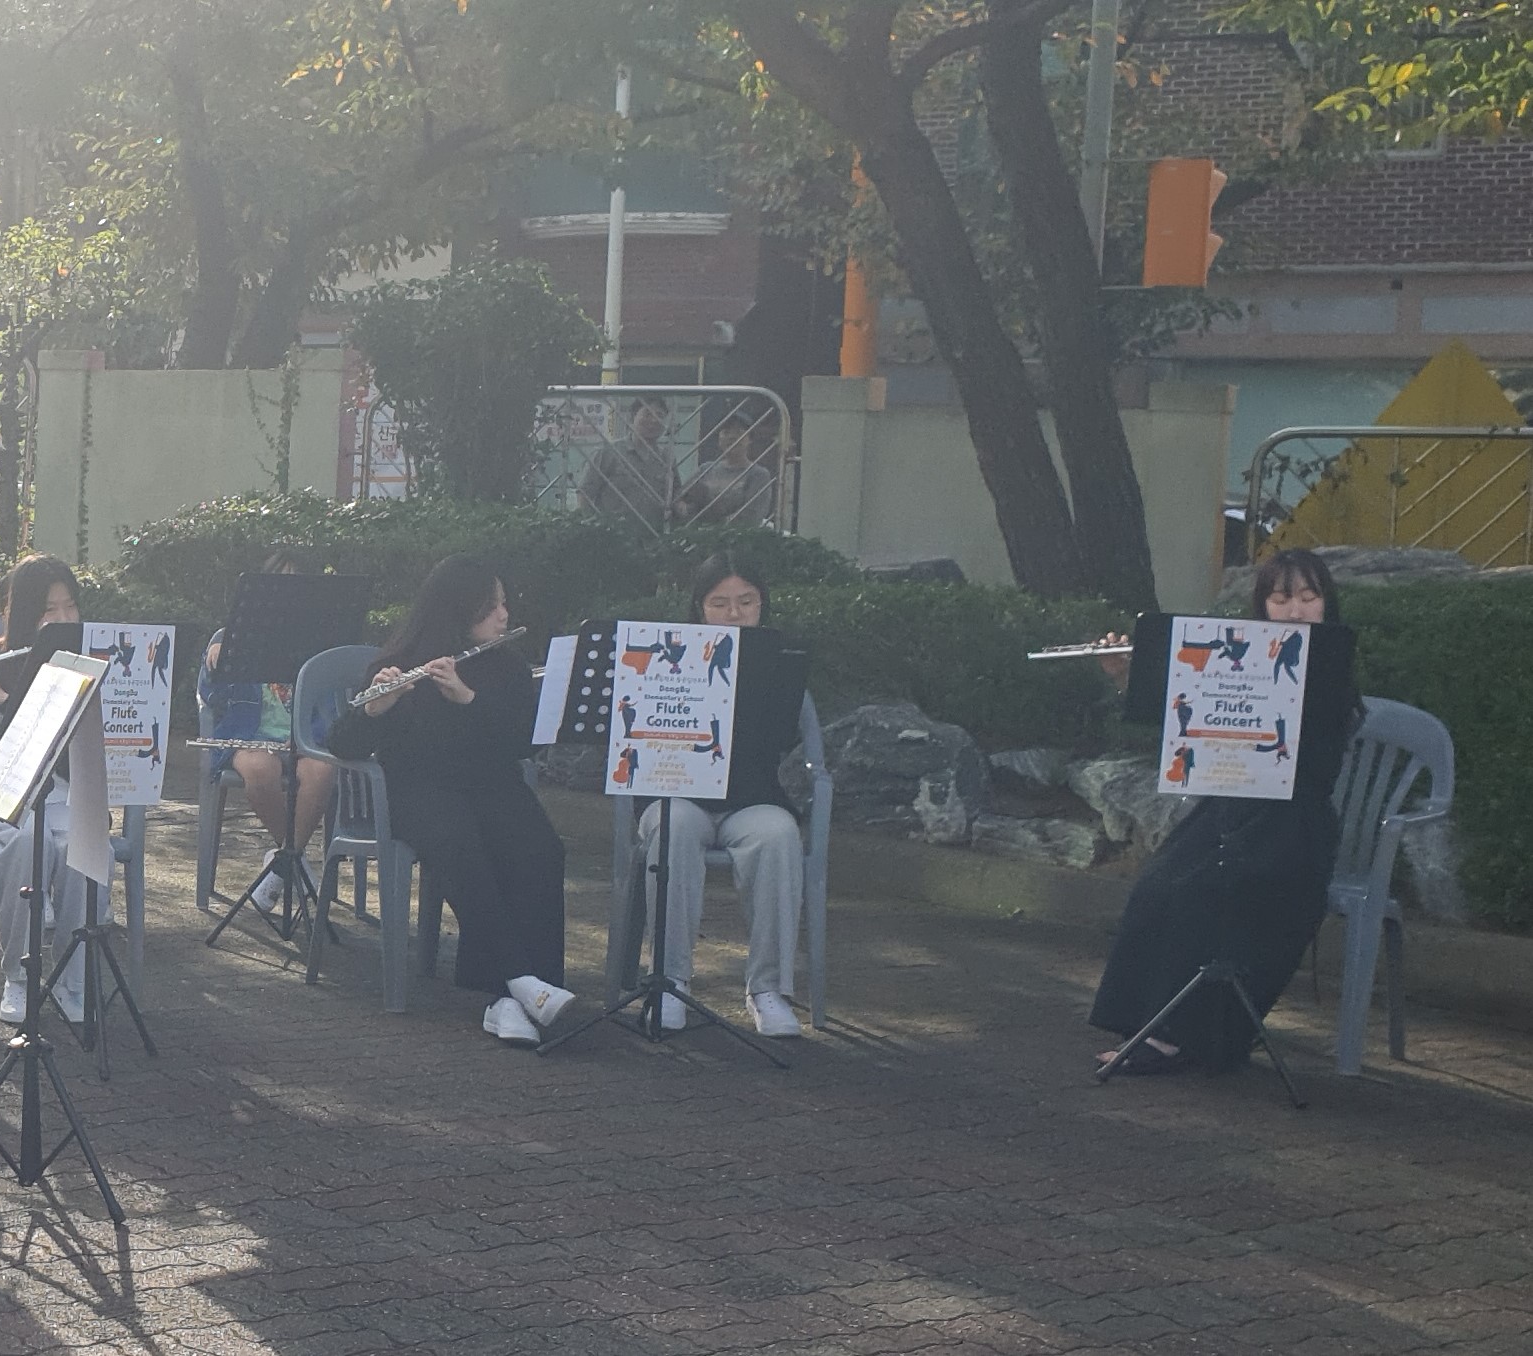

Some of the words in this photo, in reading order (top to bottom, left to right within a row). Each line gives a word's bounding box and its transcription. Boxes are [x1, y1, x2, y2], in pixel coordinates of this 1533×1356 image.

[111, 706, 138, 719] Flute
[656, 702, 691, 714] Flute
[1214, 700, 1254, 714] Flute
[103, 721, 144, 733] Concert
[646, 715, 699, 729] Concert
[1204, 713, 1262, 728] Concert
